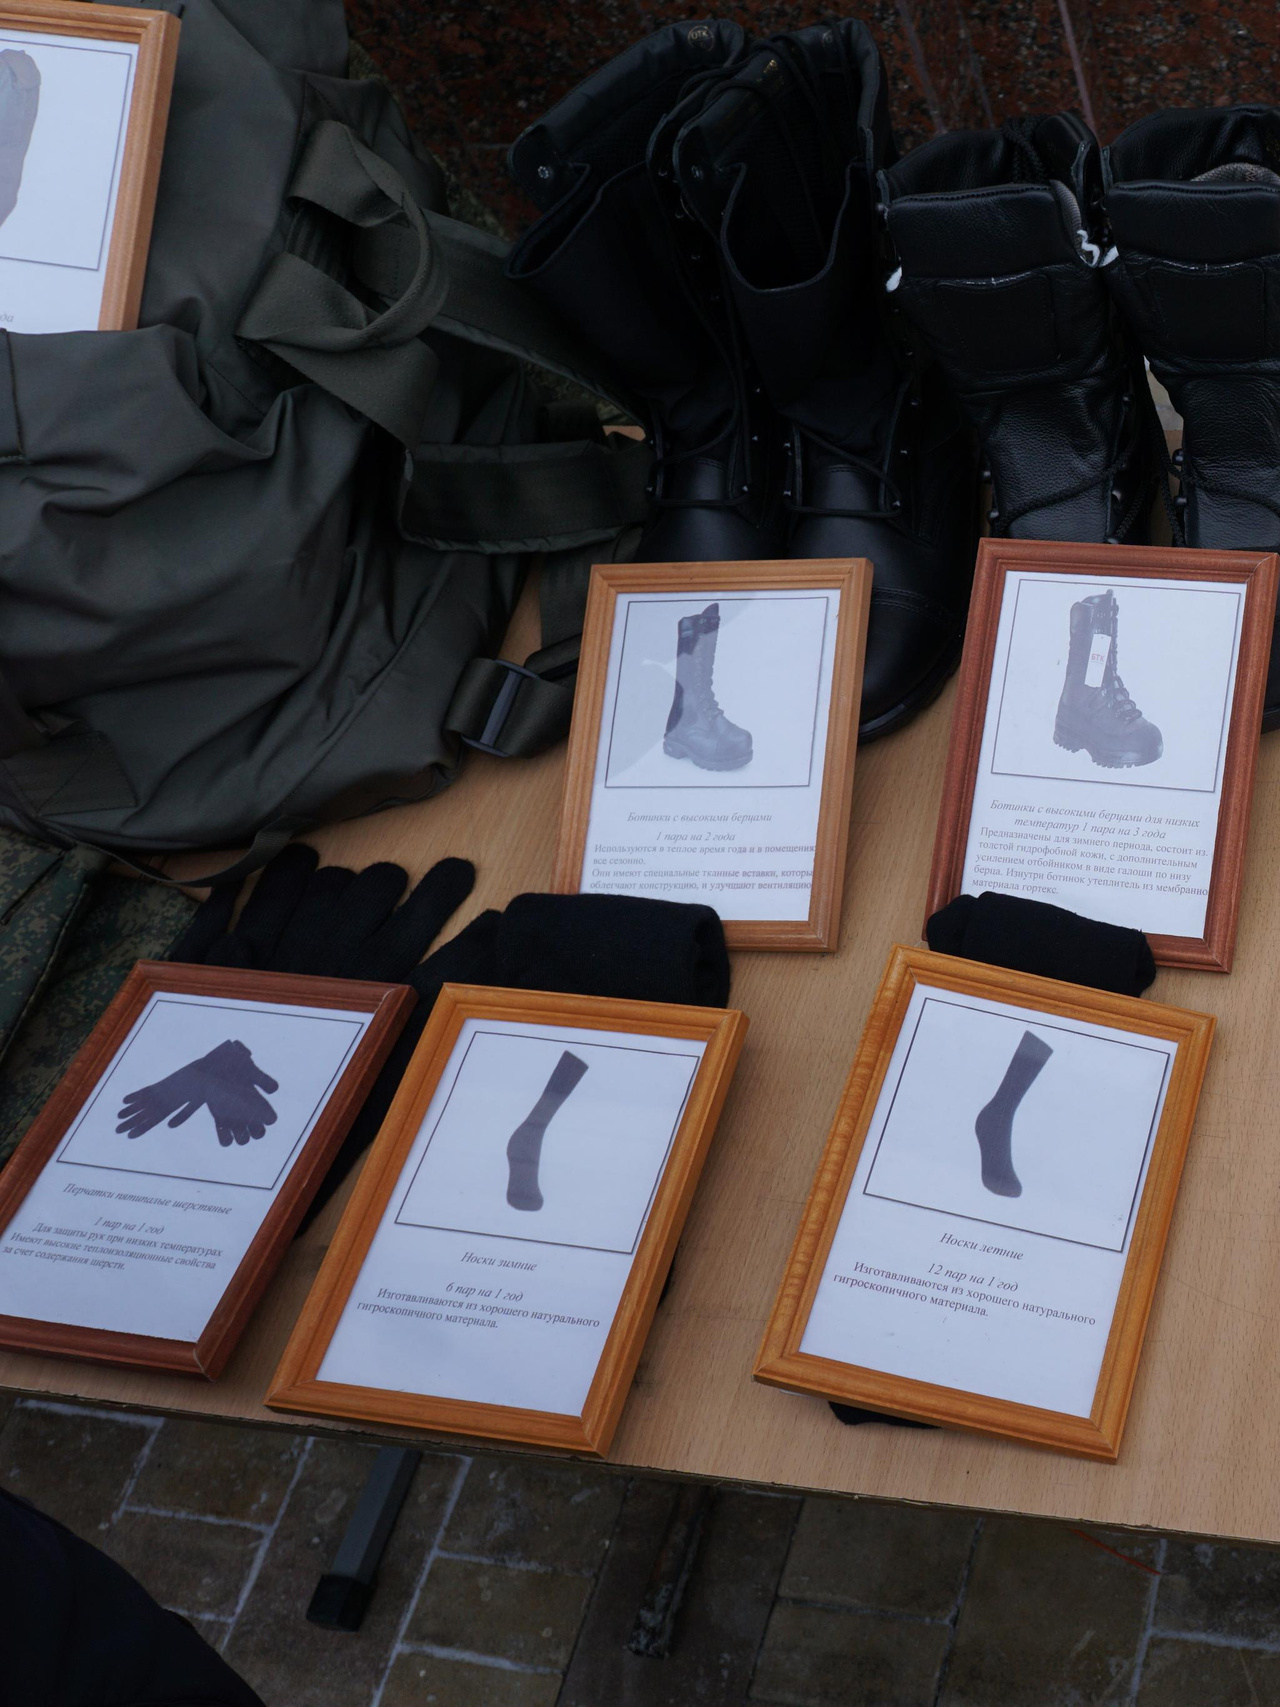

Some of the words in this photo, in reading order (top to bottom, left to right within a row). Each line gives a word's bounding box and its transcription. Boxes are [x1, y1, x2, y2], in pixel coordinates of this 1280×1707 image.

[1092, 654, 1104, 662] БТК
[990, 799, 1035, 812] Ботинки
[1045, 807, 1096, 818] высокими
[1098, 809, 1142, 822] берцами
[1144, 814, 1163, 824] для
[1164, 818, 1200, 827] низких
[980, 826, 1051, 841] Предназначены
[1052, 835, 1070, 843] для
[1072, 837, 1110, 847] зимнего
[1112, 841, 1153, 852] периода,
[1155, 845, 1193, 855] состоит
[1195, 849, 1208, 857] из.
[1014, 818, 1079, 833] температур
[1090, 825, 1116, 836] пара
[1141, 828, 1166, 839] года
[975, 854, 1025, 865] усилением
[1026, 857, 1083, 870] отбойником
[1093, 865, 1115, 874] виде
[1117, 867, 1153, 877] галоши
[1169, 872, 1192, 883] низу
[978, 841, 1014, 851] толстой
[1016, 845, 1077, 857] гидрофобной
[1079, 850, 1106, 861] кожи,
[1116, 854, 1197, 868] дополнительным
[973, 864, 1003, 876] берца.
[1005, 867, 1044, 881] Изнутри
[1046, 871, 1085, 883] ботинок
[1086, 877, 1140, 889] утеплитель
[1155, 884, 1207, 895] мембранно
[940, 1232, 978, 1250] Носки
[979, 1244, 1023, 1260] летние
[454, 1285, 476, 1297] пар
[502, 1291, 524, 1302] год
[854, 1261, 948, 1292] Изготавливаются
[966, 1289, 1019, 1308] хорошего
[1022, 1303, 1095, 1325] натурального
[944, 1269, 967, 1282] пар
[996, 1281, 1018, 1292] год
[833, 1274, 927, 1302] гигроскопичного
[929, 1296, 988, 1316] материала.
